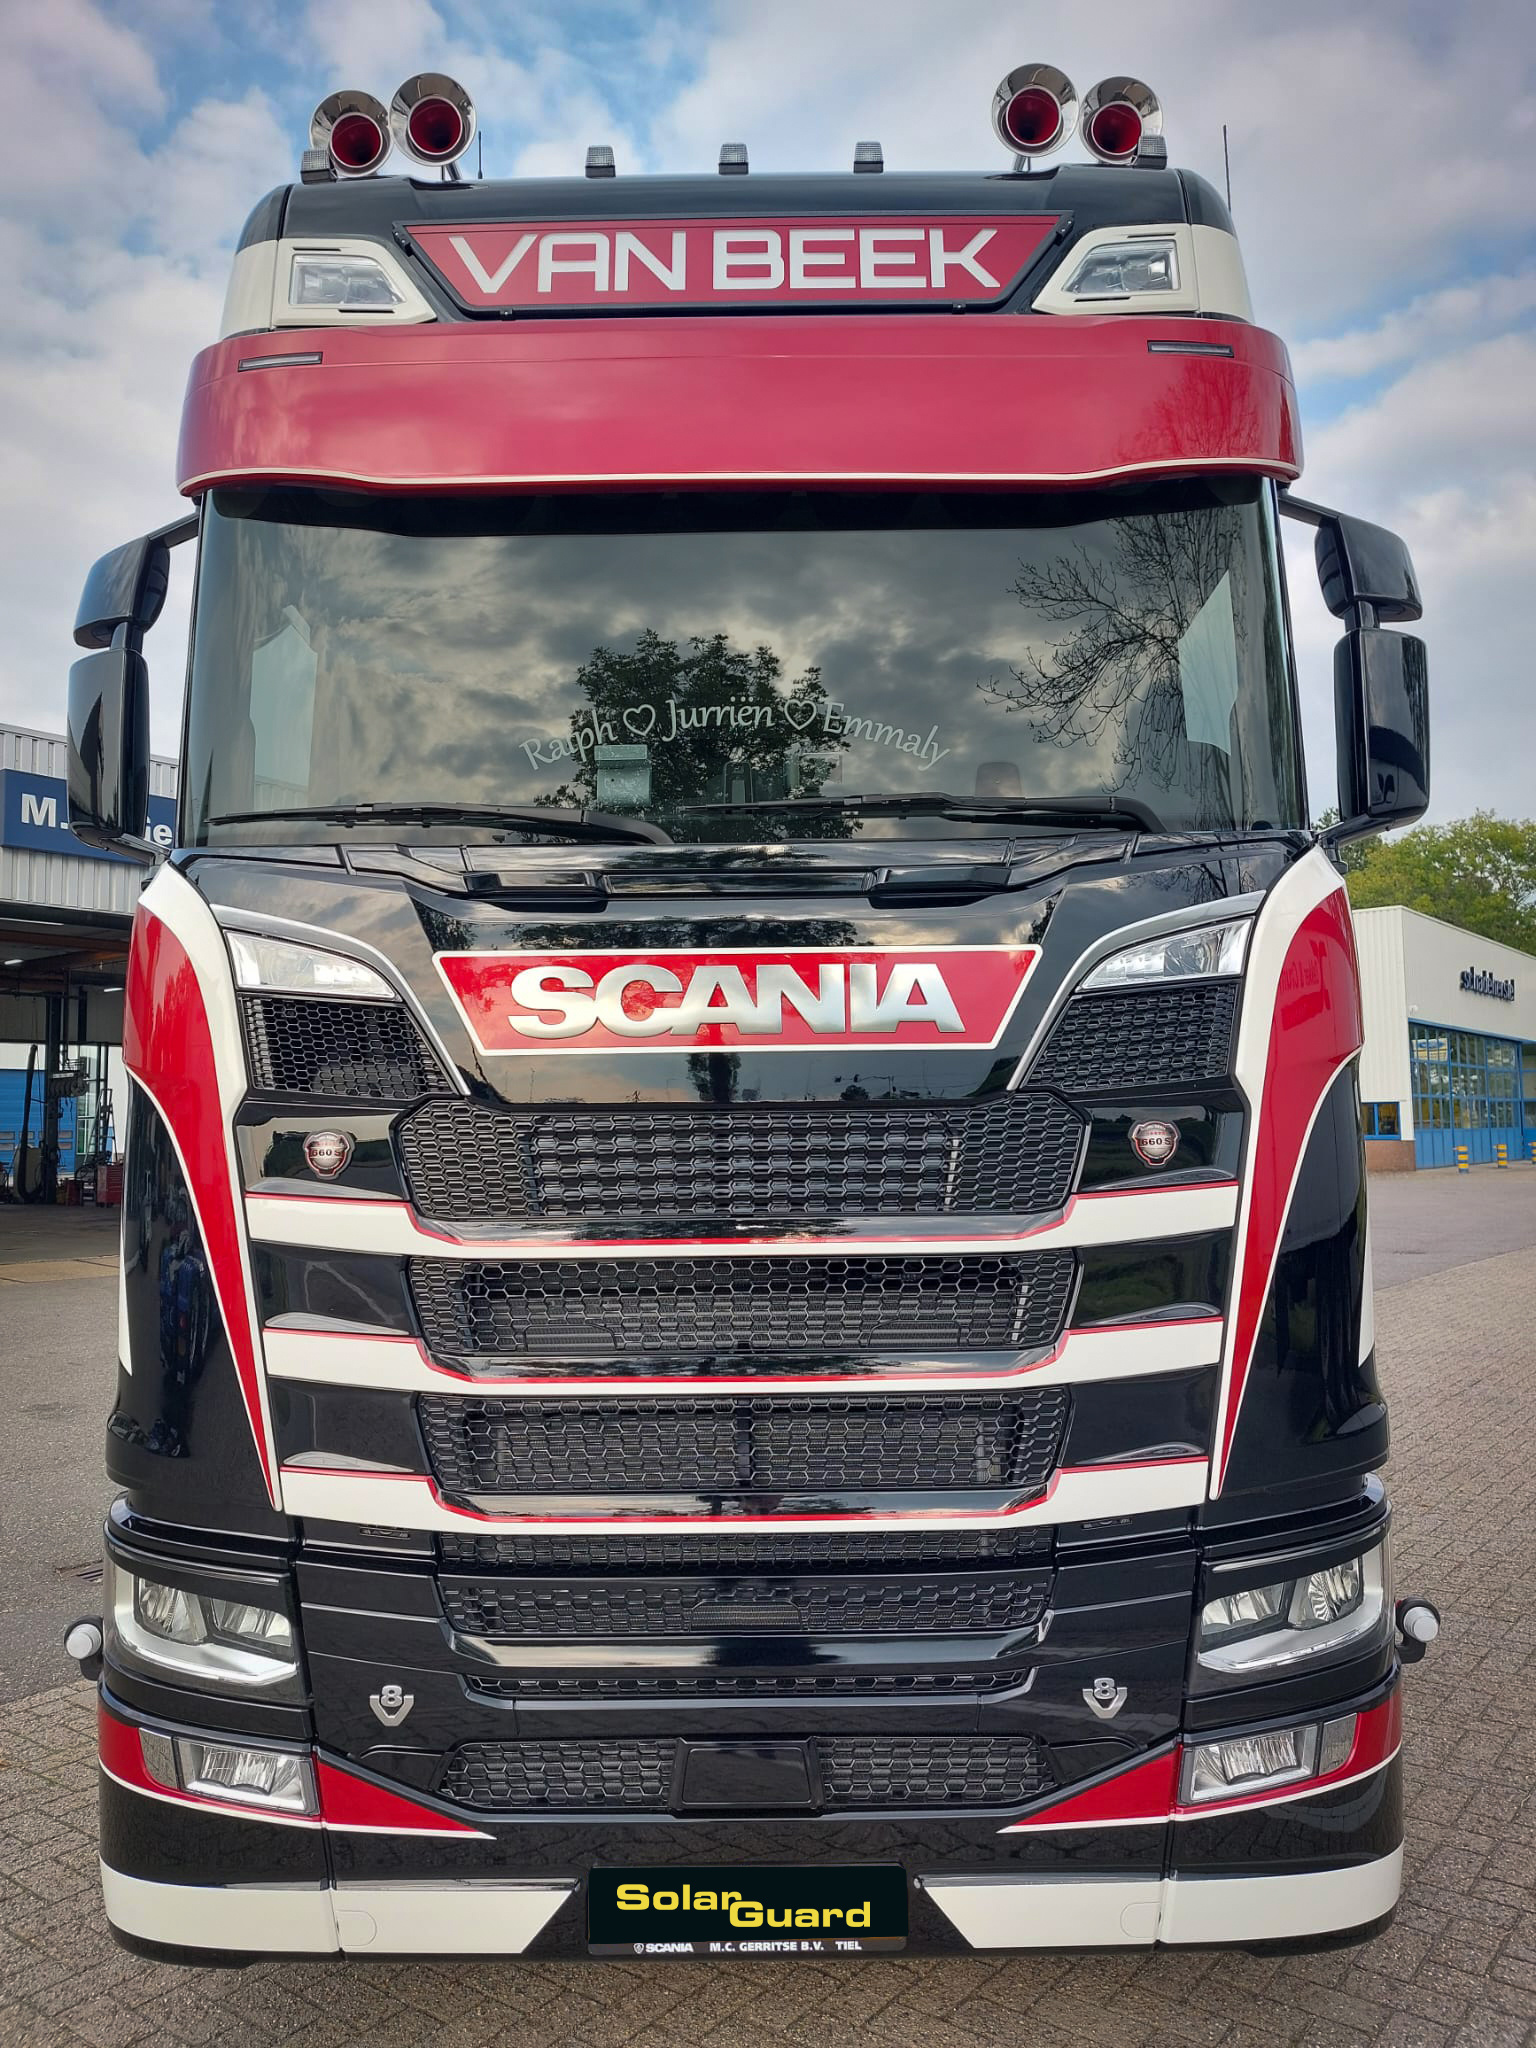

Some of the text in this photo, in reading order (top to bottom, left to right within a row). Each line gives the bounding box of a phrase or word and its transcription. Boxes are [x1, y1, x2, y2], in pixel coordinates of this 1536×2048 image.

[449, 228, 1000, 293] VAN BEEK
[661, 692, 774, 742] Jurriën
[822, 701, 951, 772] Emmaly
[507, 963, 966, 1039] SCANIA
[645, 1940, 863, 1953] SCANIA M.C. GERRITSE B.V. TIEL
